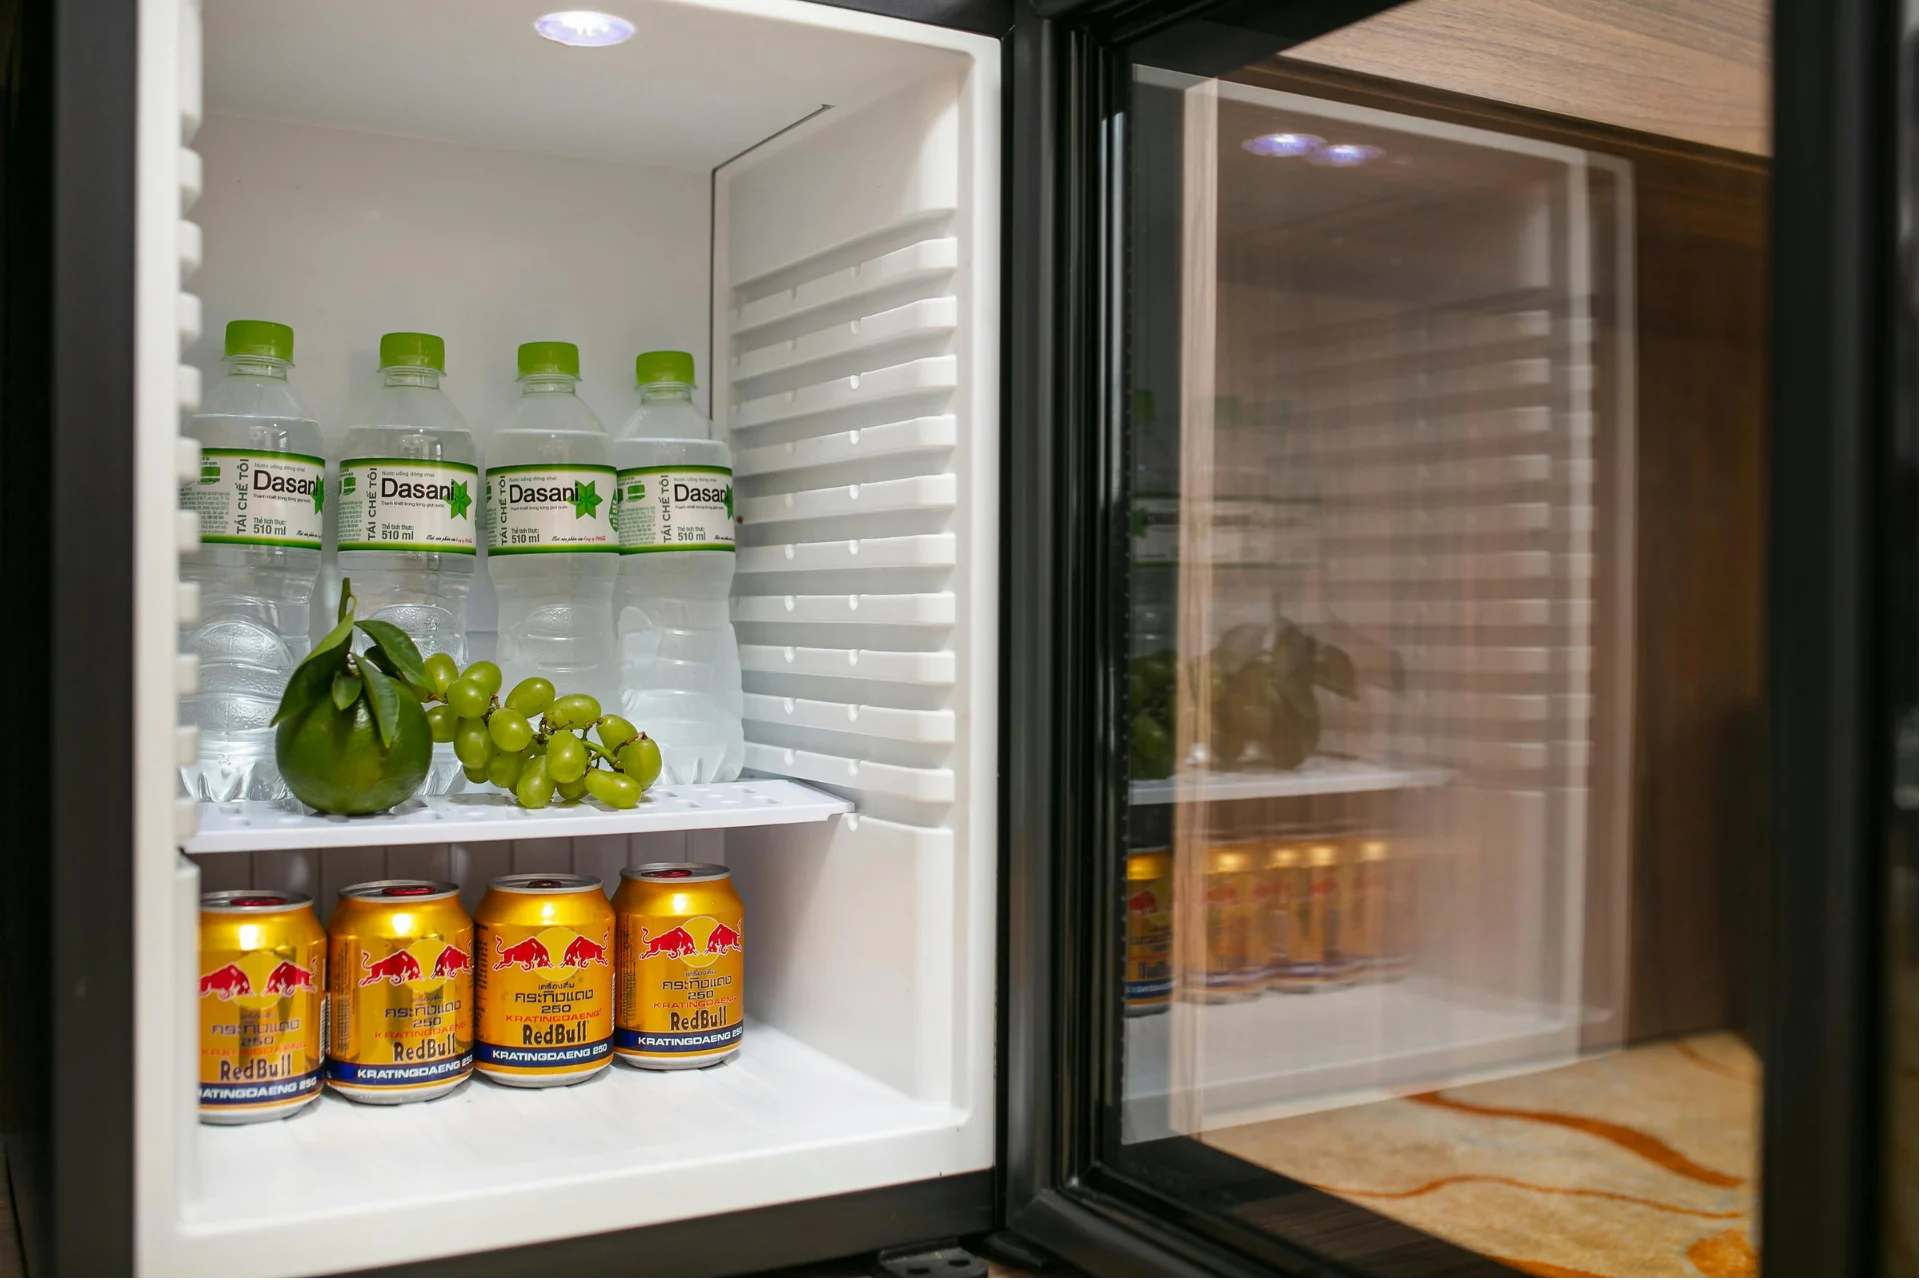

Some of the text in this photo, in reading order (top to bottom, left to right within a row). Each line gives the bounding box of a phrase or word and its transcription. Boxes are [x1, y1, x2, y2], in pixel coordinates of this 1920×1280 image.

[235, 459, 249, 534] TÁI CHẾ TÔI
[382, 478, 454, 501] Dasani
[509, 482, 579, 503] Dasani
[366, 468, 377, 541] TÁI CHẾ TÔI
[499, 498, 507, 524] CHẾ
[658, 475, 672, 543] TÁI CHẾ TÔI
[253, 524, 272, 534] 510
[274, 526, 286, 536] ml
[382, 530, 414, 540] 510 ml
[512, 534, 540, 543] 510 ml
[678, 532, 694, 541] 510
[695, 532, 706, 541] ml
[653, 996, 737, 1009] KRATINGDAENG
[688, 990, 714, 1000] 250
[506, 1010, 600, 1022] KRATINGDAENG
[541, 1004, 571, 1014] 250
[413, 1017, 442, 1028] 250
[670, 1006, 727, 1031] RedBull
[375, 1021, 466, 1039] KRATINGDAENG
[522, 1020, 586, 1045] RedBull
[241, 1036, 274, 1047] 250
[393, 1032, 456, 1062] RedBull
[638, 1033, 731, 1046] KRATINGDAENG
[492, 1044, 608, 1061] KRATINGDAENG 250
[220, 1054, 292, 1081] RedBull
[357, 1061, 461, 1079] KRATINGDAENG
[198, 1076, 317, 1099] ATINGDAENG 250
